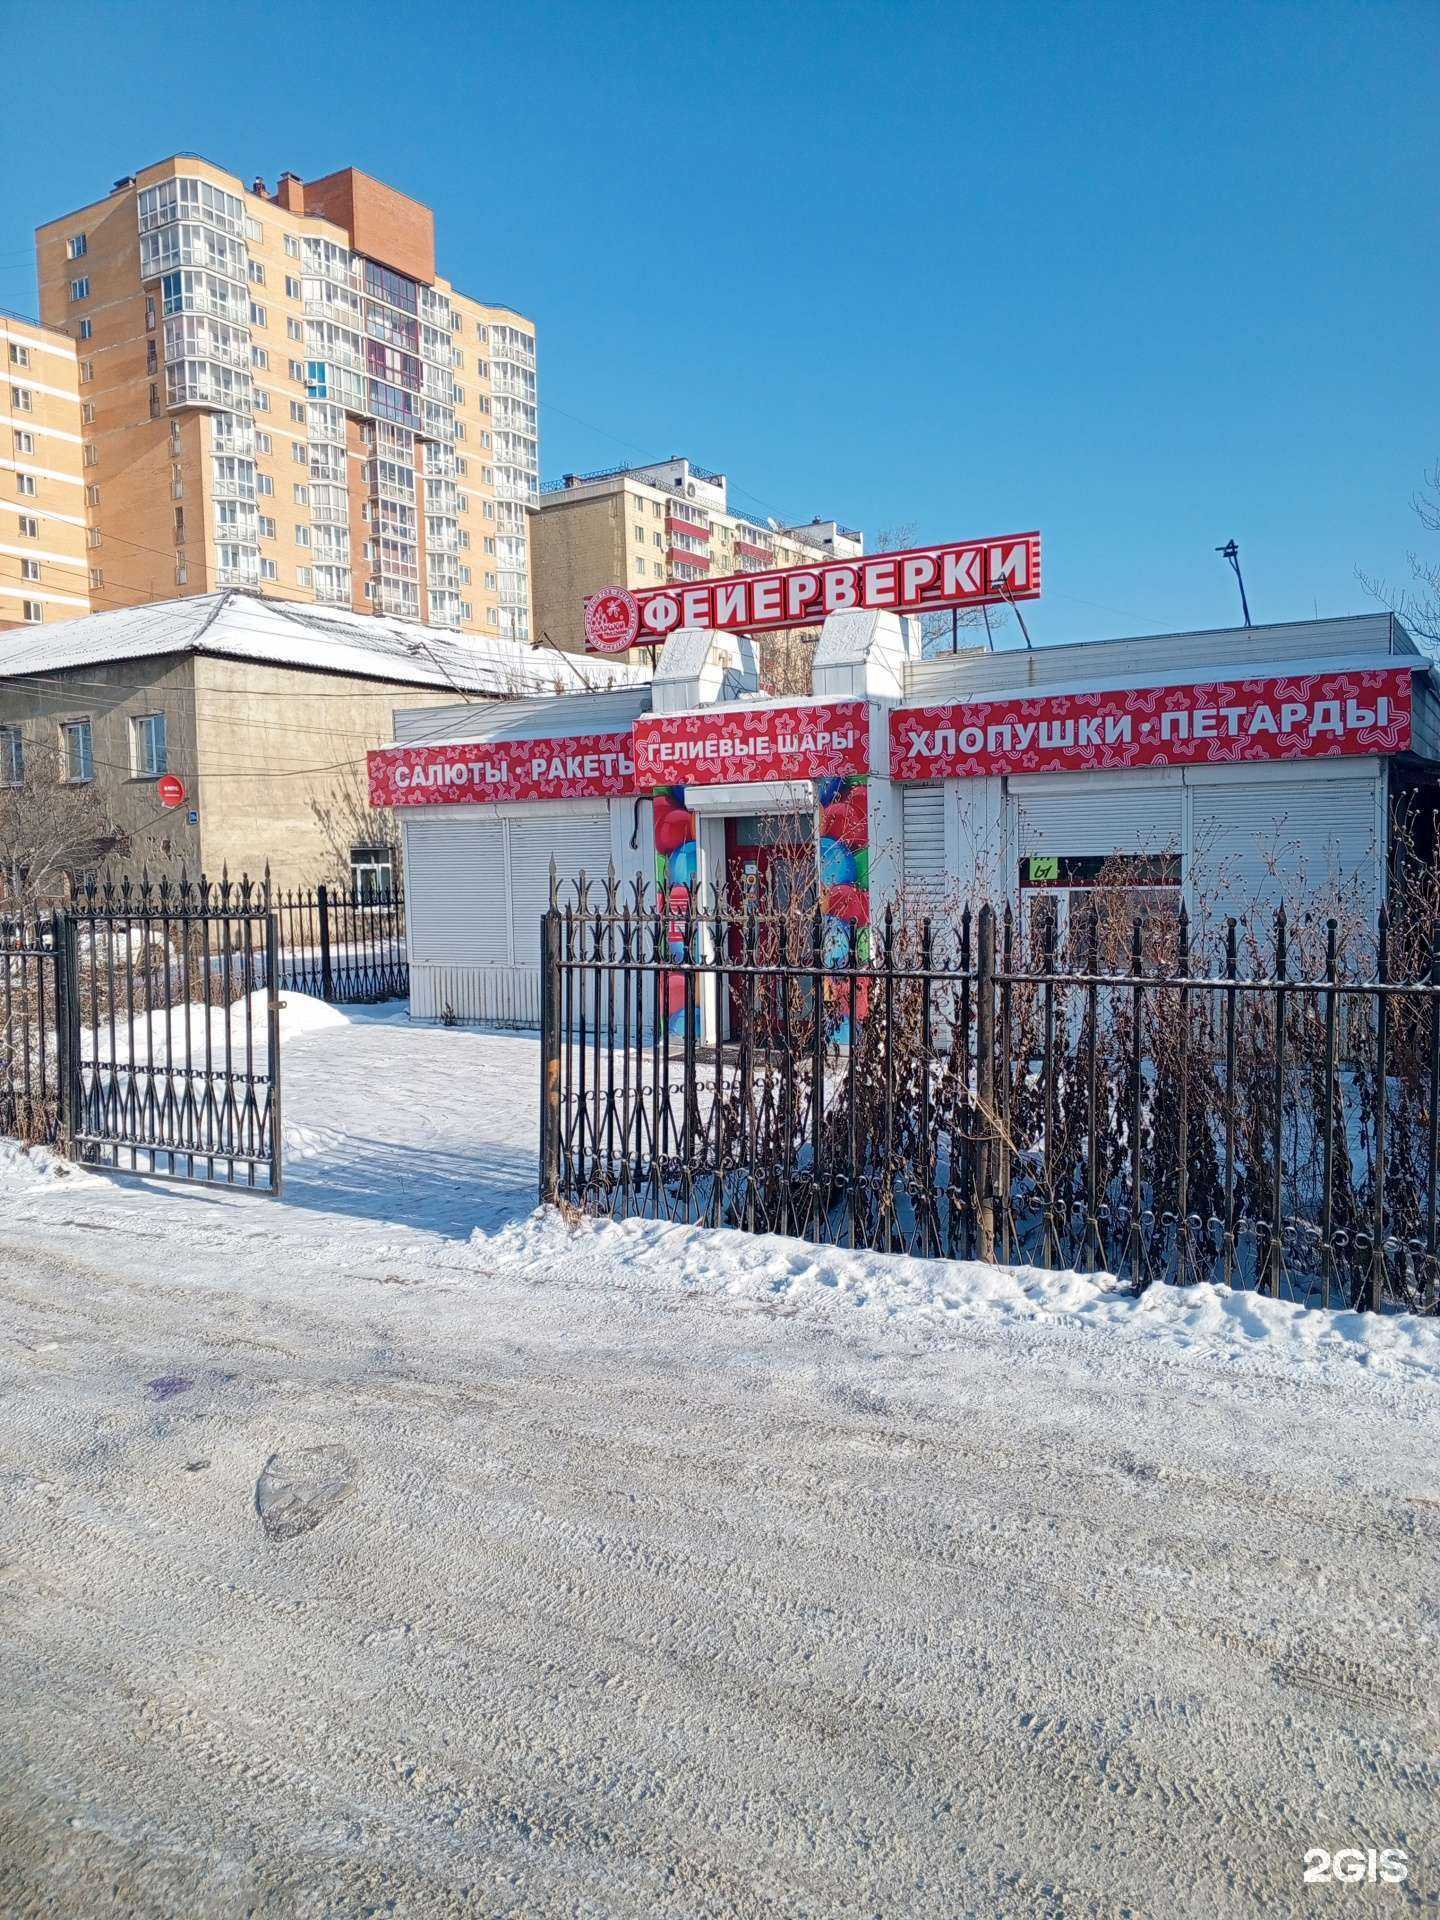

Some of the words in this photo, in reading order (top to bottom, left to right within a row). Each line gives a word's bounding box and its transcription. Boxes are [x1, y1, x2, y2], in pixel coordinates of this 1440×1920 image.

[643, 544, 1026, 630] ФЕЙЕРВЕРКИ
[647, 736, 770, 762] ГЕЛИЕВЫЕ
[777, 729, 855, 754] ШАРЫ
[907, 714, 1132, 758] ХЛОПУШКИ
[1160, 696, 1389, 741] ПЕТАРДЫ
[394, 760, 508, 788] САЛЮТЫ
